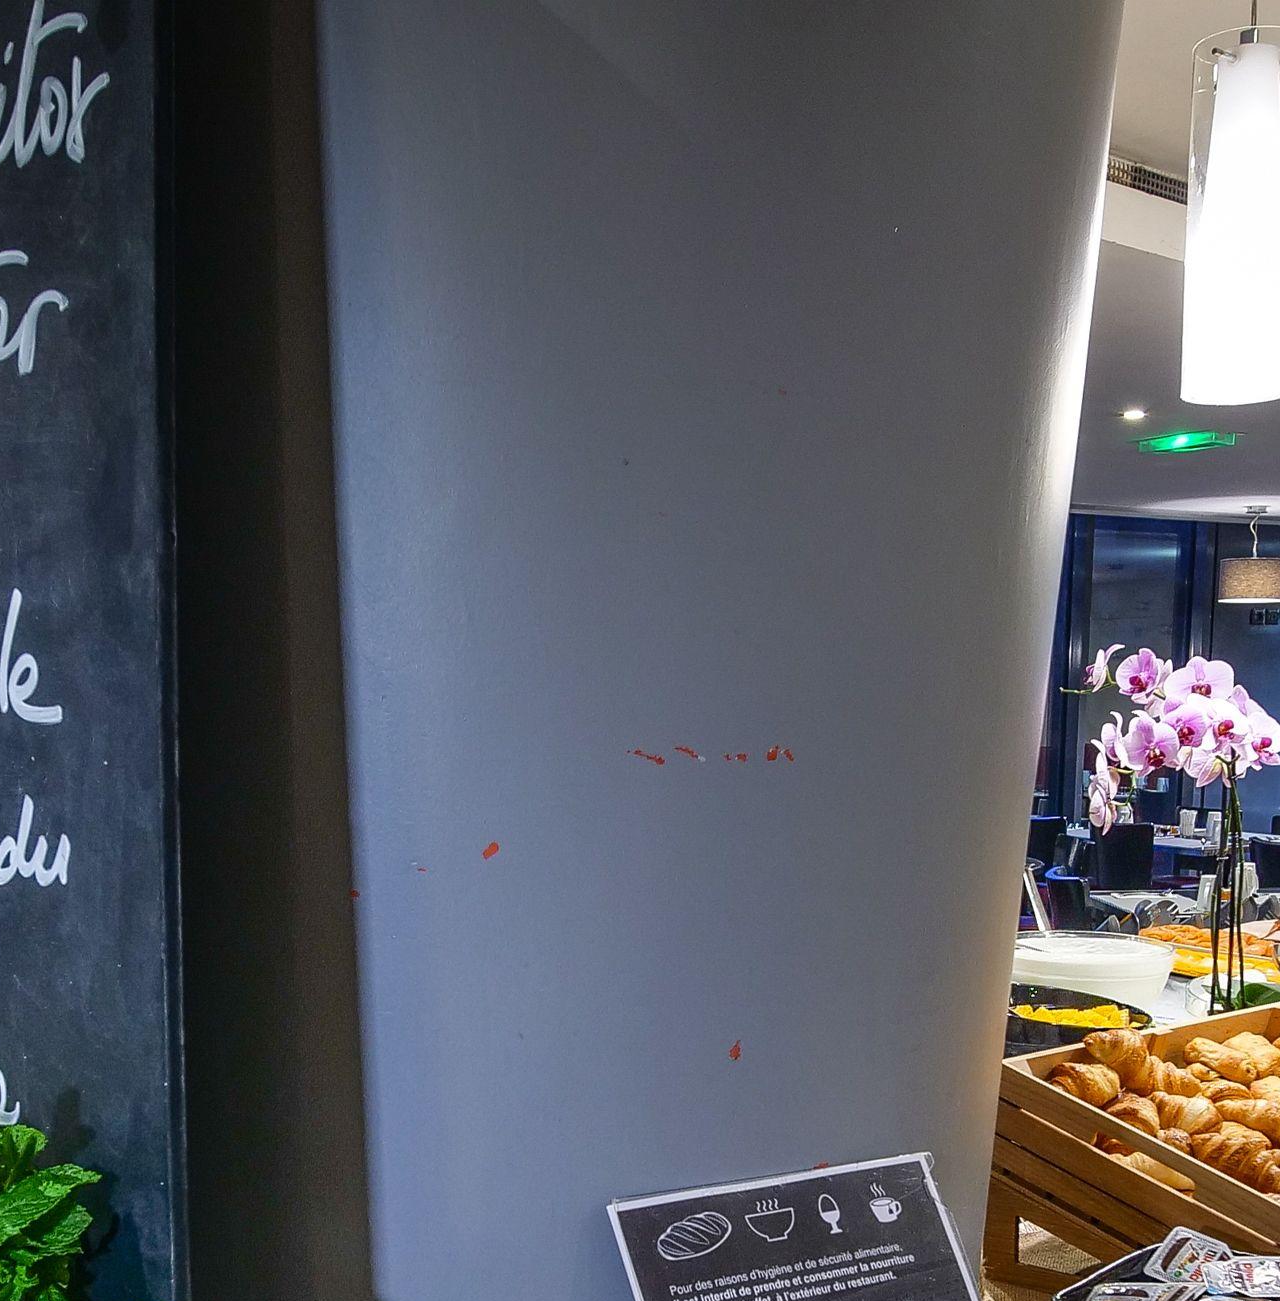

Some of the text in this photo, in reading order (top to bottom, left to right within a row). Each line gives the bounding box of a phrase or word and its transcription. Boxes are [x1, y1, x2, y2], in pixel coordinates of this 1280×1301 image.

[0, 588, 63, 724] le
[669, 1283, 693, 1296] Pour
[694, 1279, 714, 1292] des
[714, 1273, 749, 1288] raisons
[749, 1264, 793, 1281] d'hygiène
[793, 1261, 805, 1272] et
[804, 1258, 817, 1270] de
[817, 1250, 853, 1267] sécurité
[738, 1285, 752, 1297] de
[752, 1278, 791, 1296] prendre
[791, 1275, 803, 1286] et
[803, 1265, 859, 1284] consommer
[858, 1262, 870, 1272] la
[869, 1254, 915, 1270] nourriture
[783, 1284, 831, 1301] l'extérieur
[832, 1280, 847, 1292] du
[846, 1270, 897, 1289] restaurant.
